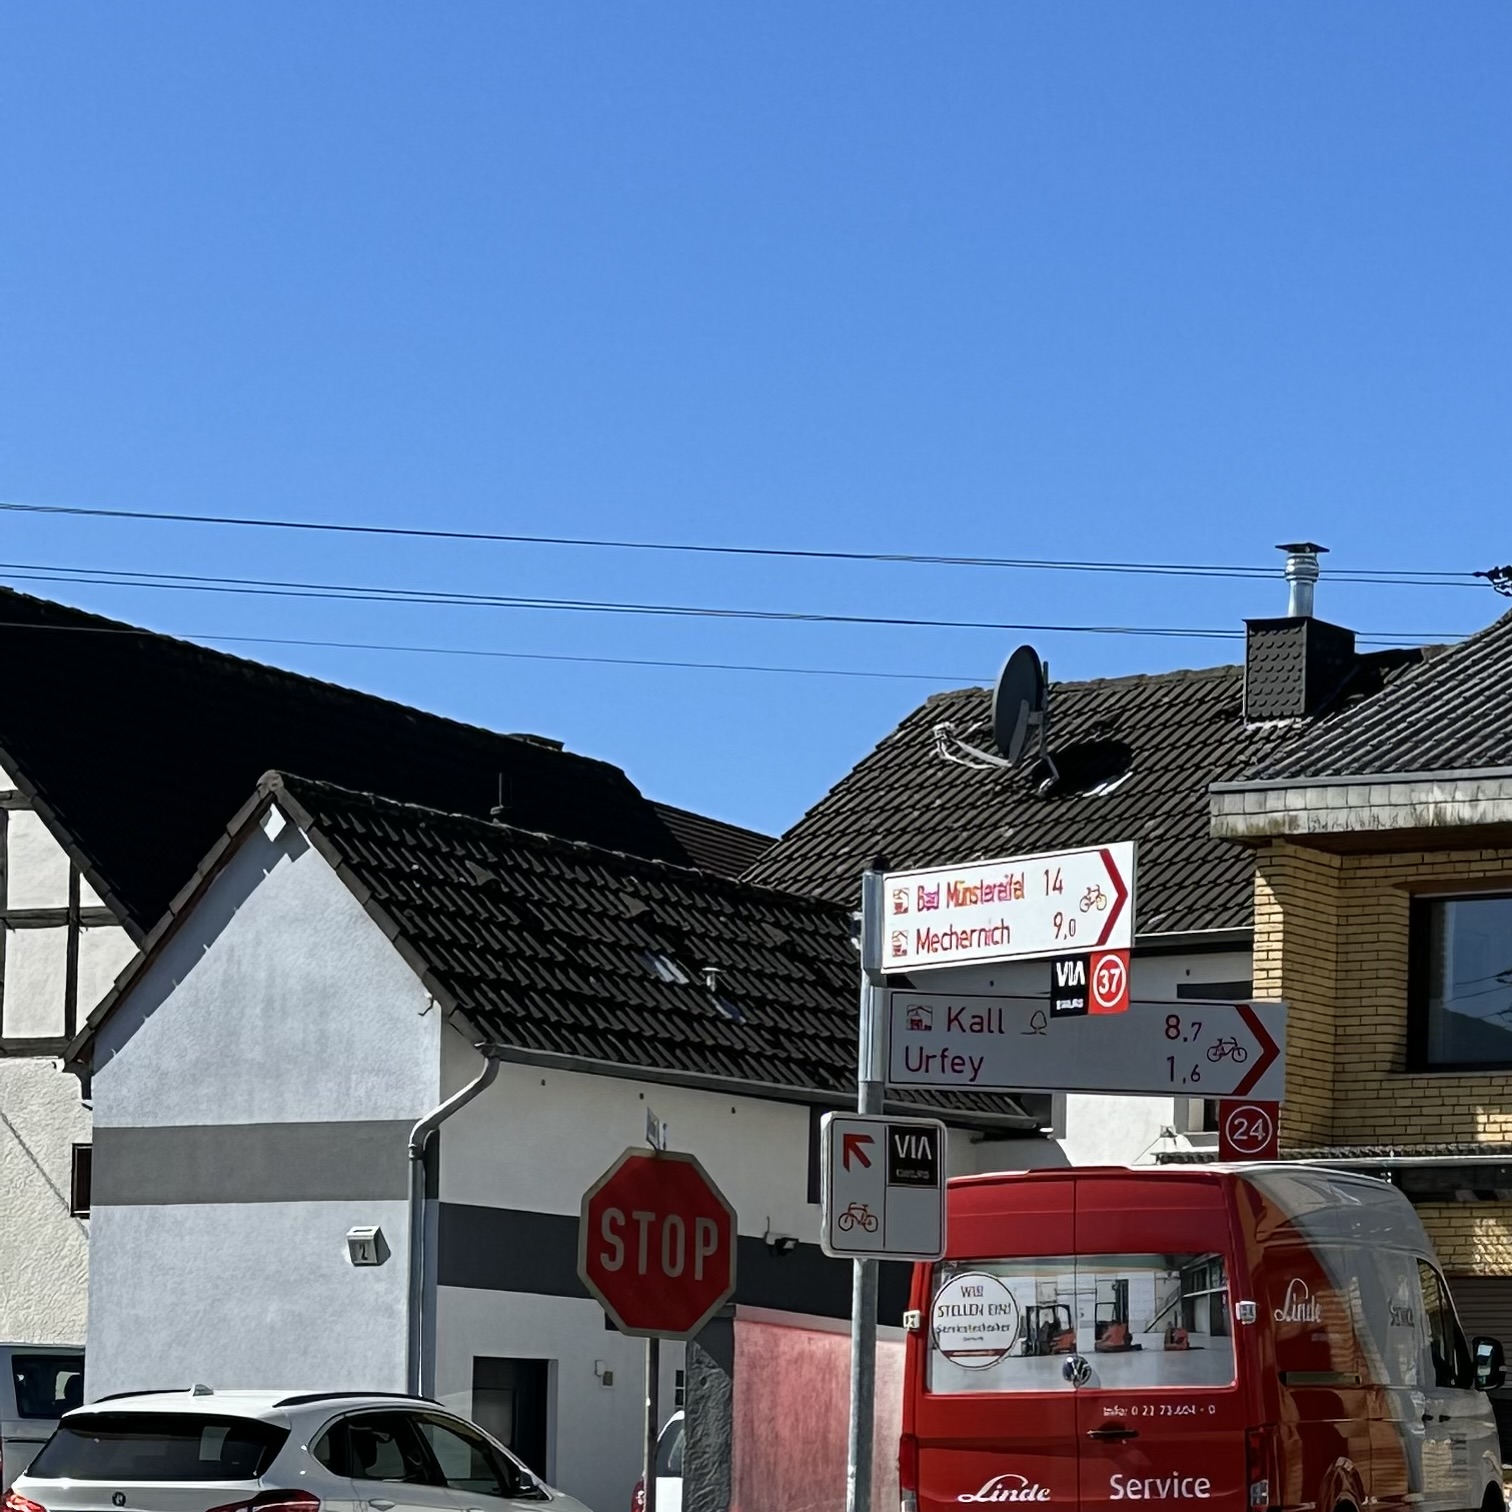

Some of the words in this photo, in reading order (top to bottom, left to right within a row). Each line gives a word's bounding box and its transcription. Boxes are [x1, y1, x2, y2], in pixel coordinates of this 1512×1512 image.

[917, 882, 940, 912] Bad
[1044, 867, 1064, 897] 14
[916, 918, 1010, 956] Mechernich
[1053, 912, 1076, 940] 9,0
[1056, 960, 1086, 987] VIA
[1099, 968, 1121, 995] 37
[946, 1006, 1006, 1035] Kall
[904, 1046, 985, 1083] Urfey
[1166, 1055, 1201, 1085] 1,6
[1232, 1118, 1266, 1141] 24
[894, 1134, 932, 1160] VIA
[600, 1207, 719, 1281] STOP
[1274, 1278, 1323, 1323] Linde
[957, 1473, 1051, 1502] Linde
[1109, 1470, 1211, 1500] Service
